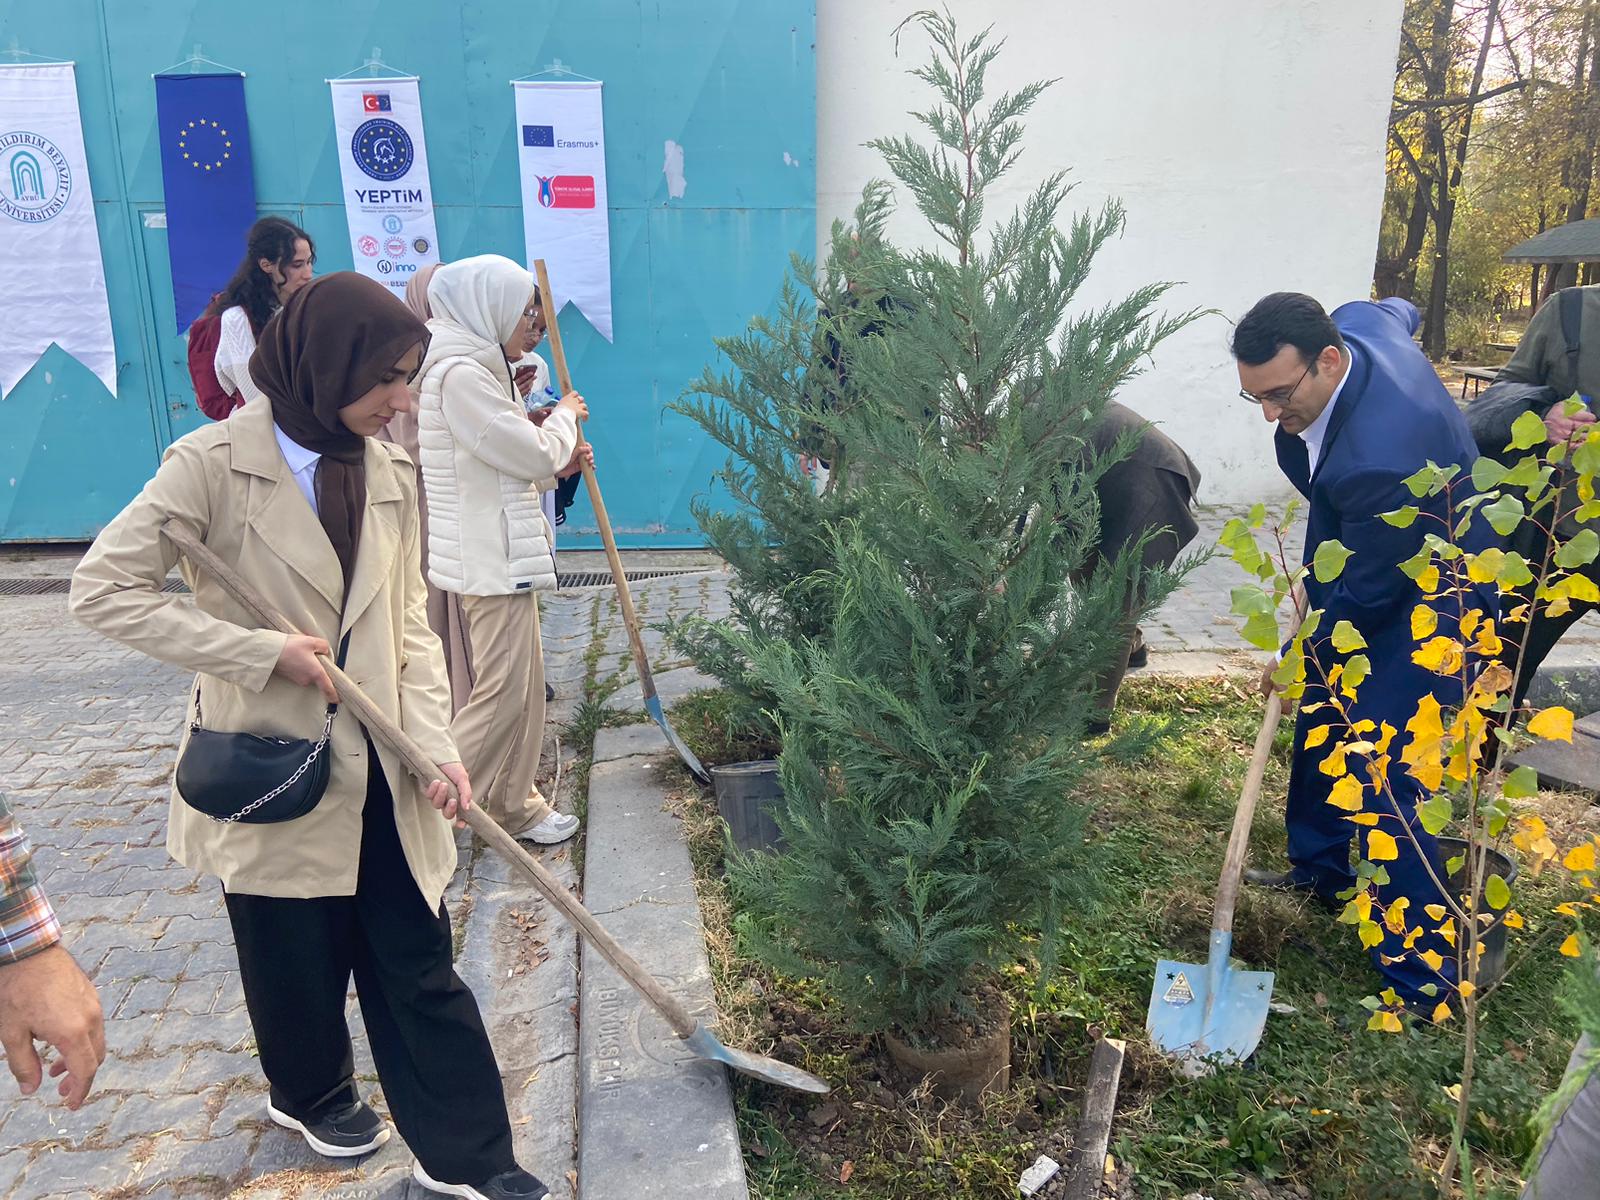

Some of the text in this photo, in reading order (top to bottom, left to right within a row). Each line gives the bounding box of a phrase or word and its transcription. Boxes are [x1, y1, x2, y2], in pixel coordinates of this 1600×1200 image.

[557, 139, 599, 148] Erasmus+
[0, 134, 69, 192] ILDIRIM BEYAZIT
